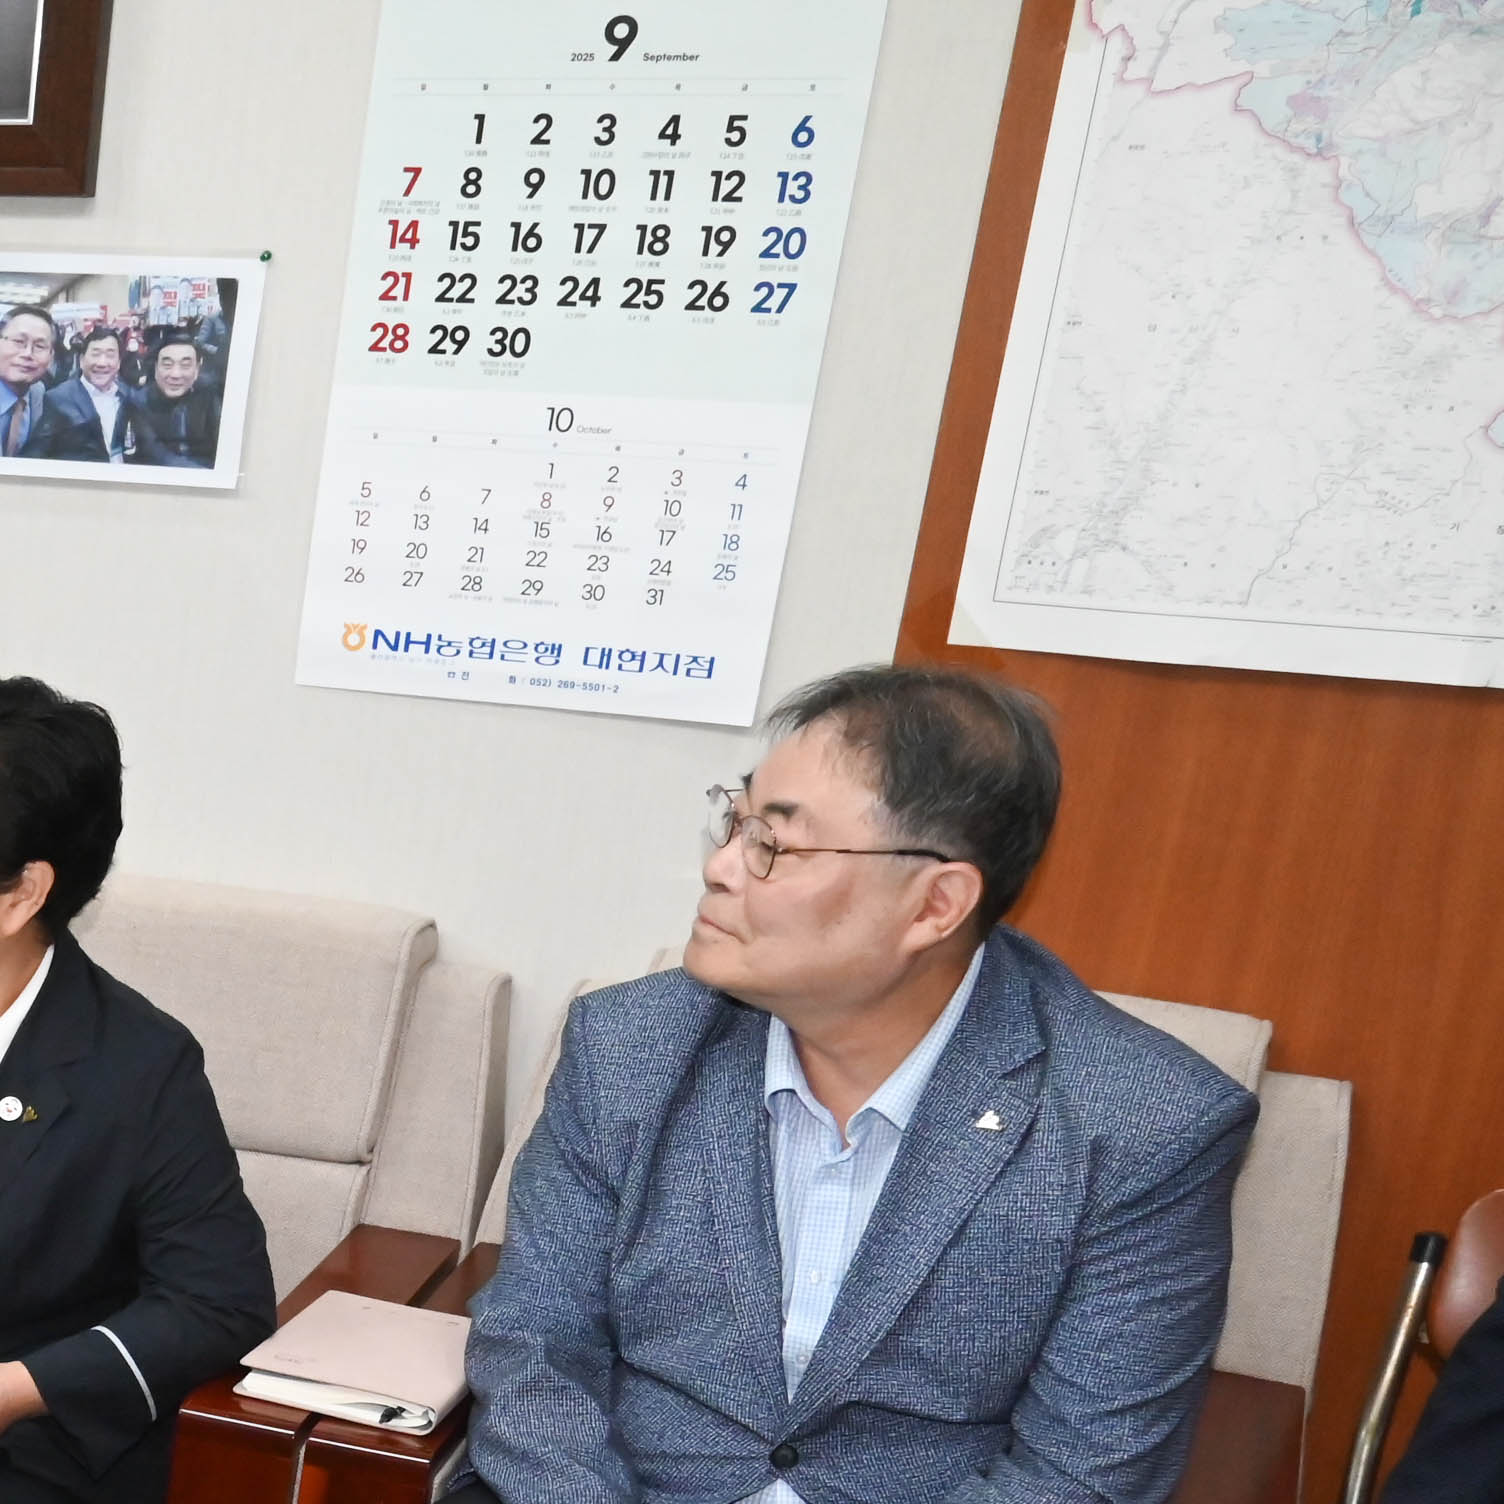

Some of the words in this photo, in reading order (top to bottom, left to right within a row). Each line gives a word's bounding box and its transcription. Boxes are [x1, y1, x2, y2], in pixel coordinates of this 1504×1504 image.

[570, 52, 595, 63] 2025
[604, 15, 638, 62] 9
[643, 52, 700, 64] September
[474, 113, 486, 145] 1
[530, 113, 553, 145] 2
[594, 113, 617, 146] 3
[658, 114, 681, 146] 4
[724, 115, 748, 147] 5
[791, 115, 815, 148] 6
[403, 167, 422, 197] 7
[460, 167, 482, 198] 8
[524, 168, 545, 199] 9
[580, 168, 616, 201] 10
[649, 170, 675, 201] 11
[711, 170, 745, 202] 12
[777, 171, 813, 204] 13
[388, 220, 420, 250] 14
[448, 221, 481, 252] 15
[510, 222, 542, 253] 16
[574, 223, 607, 254] 17
[636, 224, 671, 256] 18
[701, 225, 736, 257] 19
[758, 226, 807, 260] 20
[378, 271, 412, 301] 21
[435, 272, 477, 304] 22
[495, 274, 539, 306] 23
[557, 276, 601, 308] 24
[620, 277, 665, 310] 25
[684, 279, 729, 312] 26
[750, 281, 798, 314] 27
[368, 322, 410, 353] 28
[427, 324, 470, 355] 29
[487, 326, 531, 358] 30
[547, 407, 574, 432] 10
[577, 425, 612, 436] October
[548, 463, 555, 480] 1
[607, 466, 620, 483] 2
[670, 470, 684, 487] 3
[734, 474, 748, 490] 4
[360, 482, 372, 498] 5
[419, 486, 431, 502] 6
[481, 489, 492, 504] 7
[540, 492, 553, 509] 8
[602, 496, 615, 512] 9
[663, 500, 682, 517] 10
[730, 503, 744, 520] 11
[355, 510, 371, 526] 12
[413, 514, 430, 530] 13
[472, 518, 490, 534] 14
[533, 521, 551, 538] 15
[595, 526, 613, 542] 16
[658, 530, 677, 546] 17
[722, 534, 741, 551] 18
[351, 539, 368, 554] 19
[404, 543, 428, 559] 20
[467, 546, 485, 563] 21
[525, 551, 548, 568] 22
[586, 555, 610, 572] 23
[648, 559, 672, 576] 24
[712, 564, 737, 581] 25
[343, 567, 365, 583] 26
[401, 571, 424, 588] 27
[460, 575, 483, 592] 28
[520, 579, 544, 596] 29
[581, 584, 605, 601] 30
[645, 588, 665, 605] 31
[372, 628, 563, 667] NH농협은행
[583, 646, 716, 680] 대현지점
